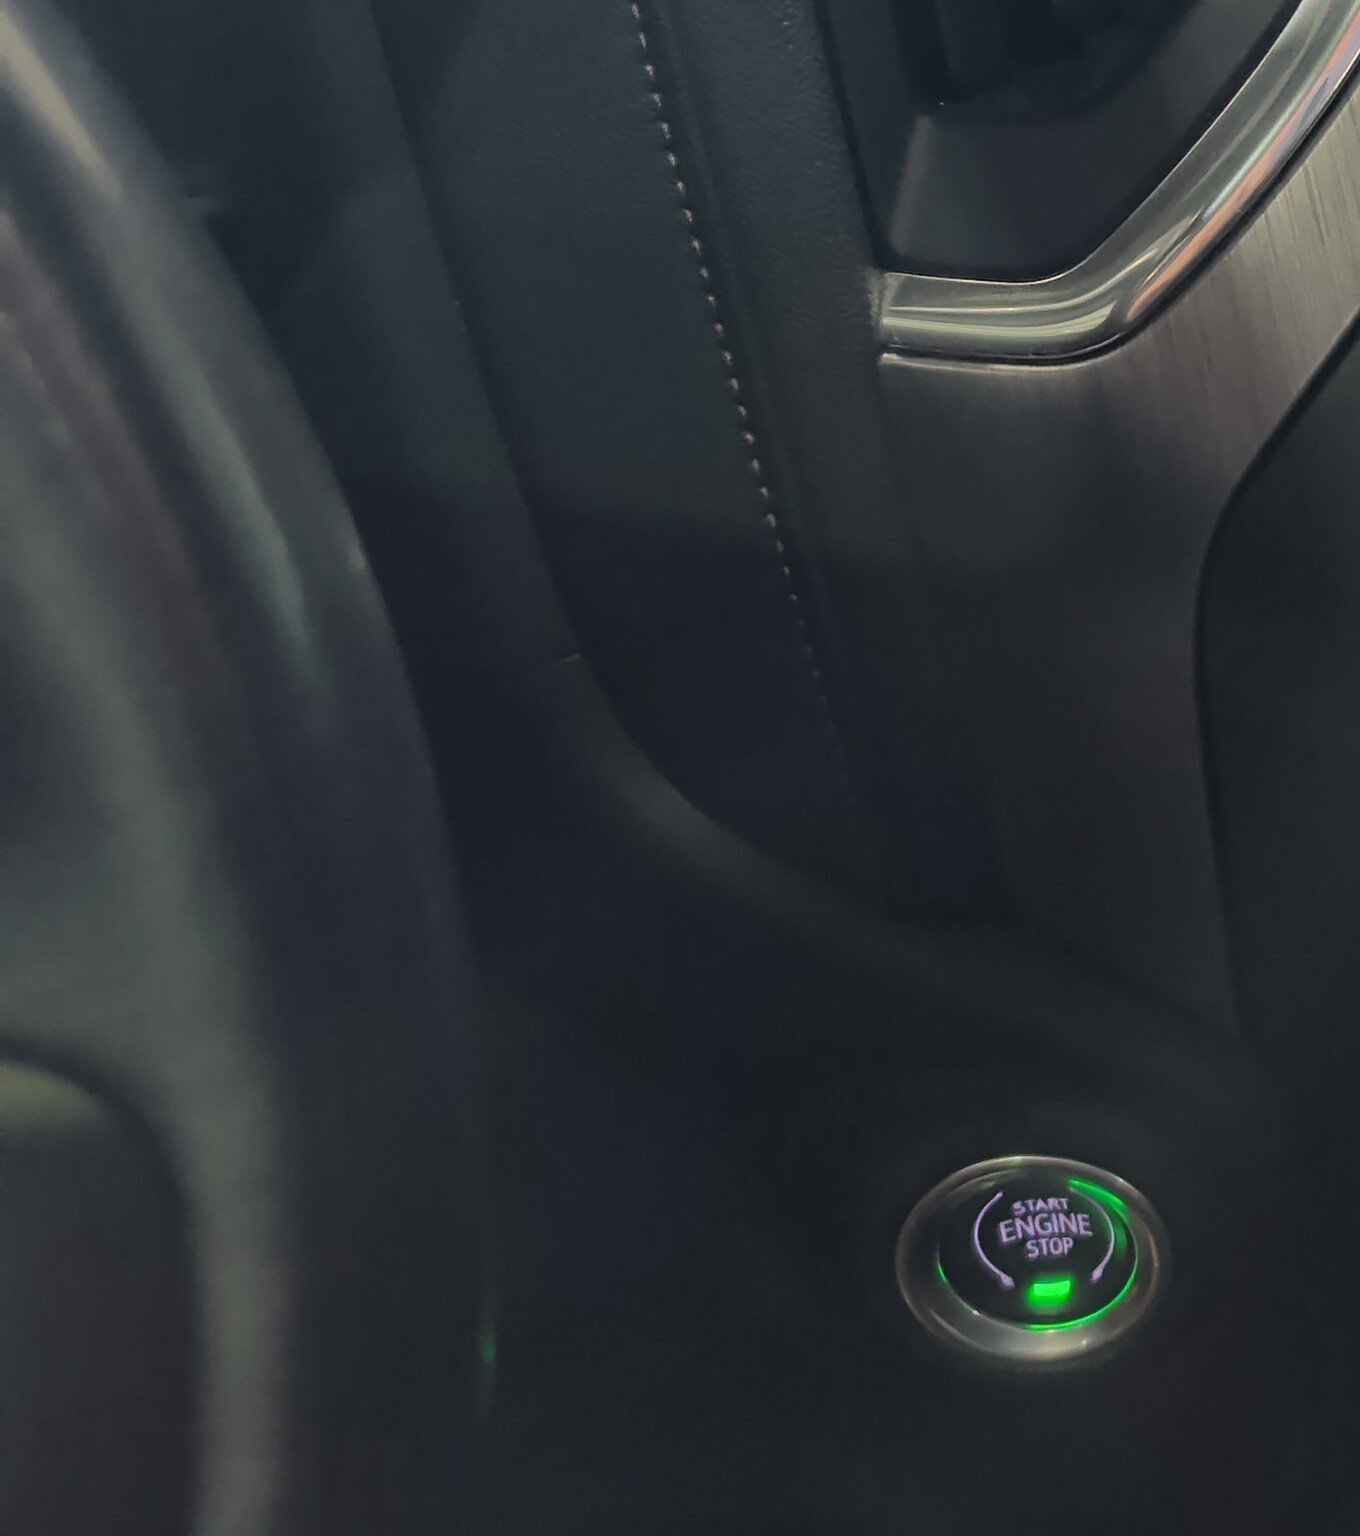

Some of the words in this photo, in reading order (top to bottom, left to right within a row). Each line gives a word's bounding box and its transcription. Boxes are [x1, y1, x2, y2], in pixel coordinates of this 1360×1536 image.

[1012, 1197, 1069, 1217] START
[999, 1212, 1094, 1244] ENGINE
[1025, 1236, 1075, 1259] STOP
